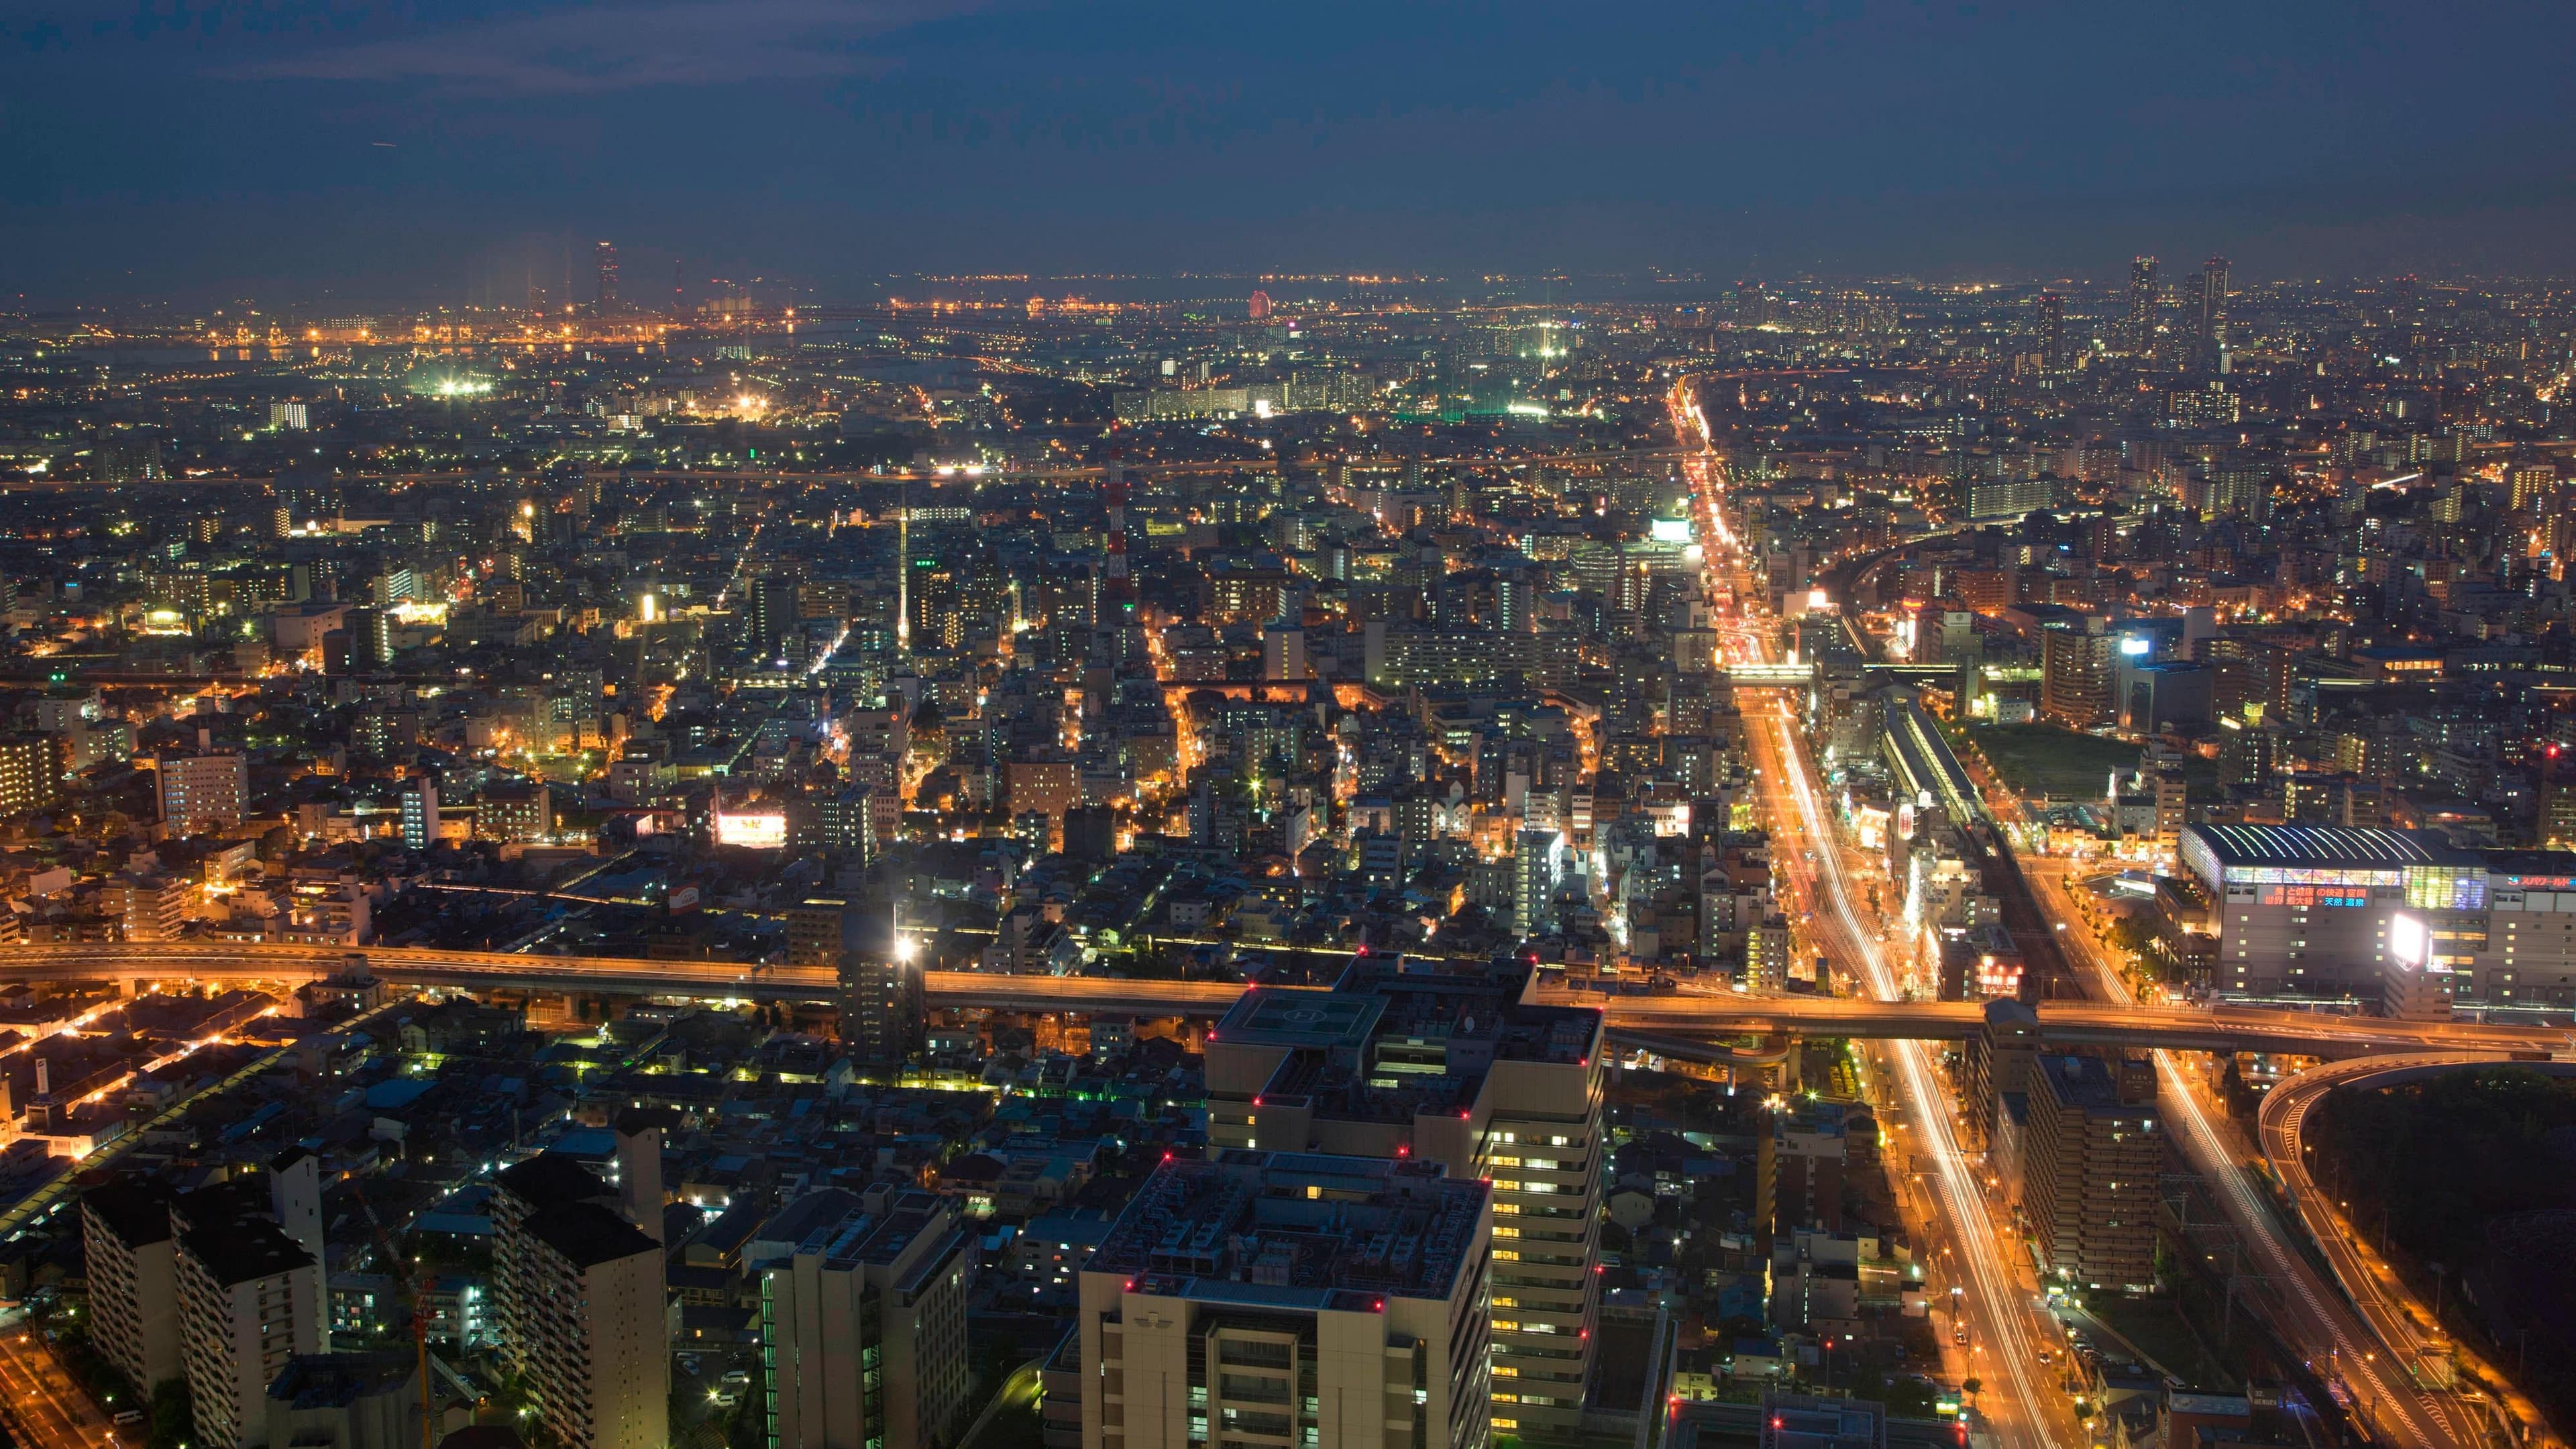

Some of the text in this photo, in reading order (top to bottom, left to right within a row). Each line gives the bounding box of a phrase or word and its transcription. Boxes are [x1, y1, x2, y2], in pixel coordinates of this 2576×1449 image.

[2521, 876, 2570, 886] スパワールド
